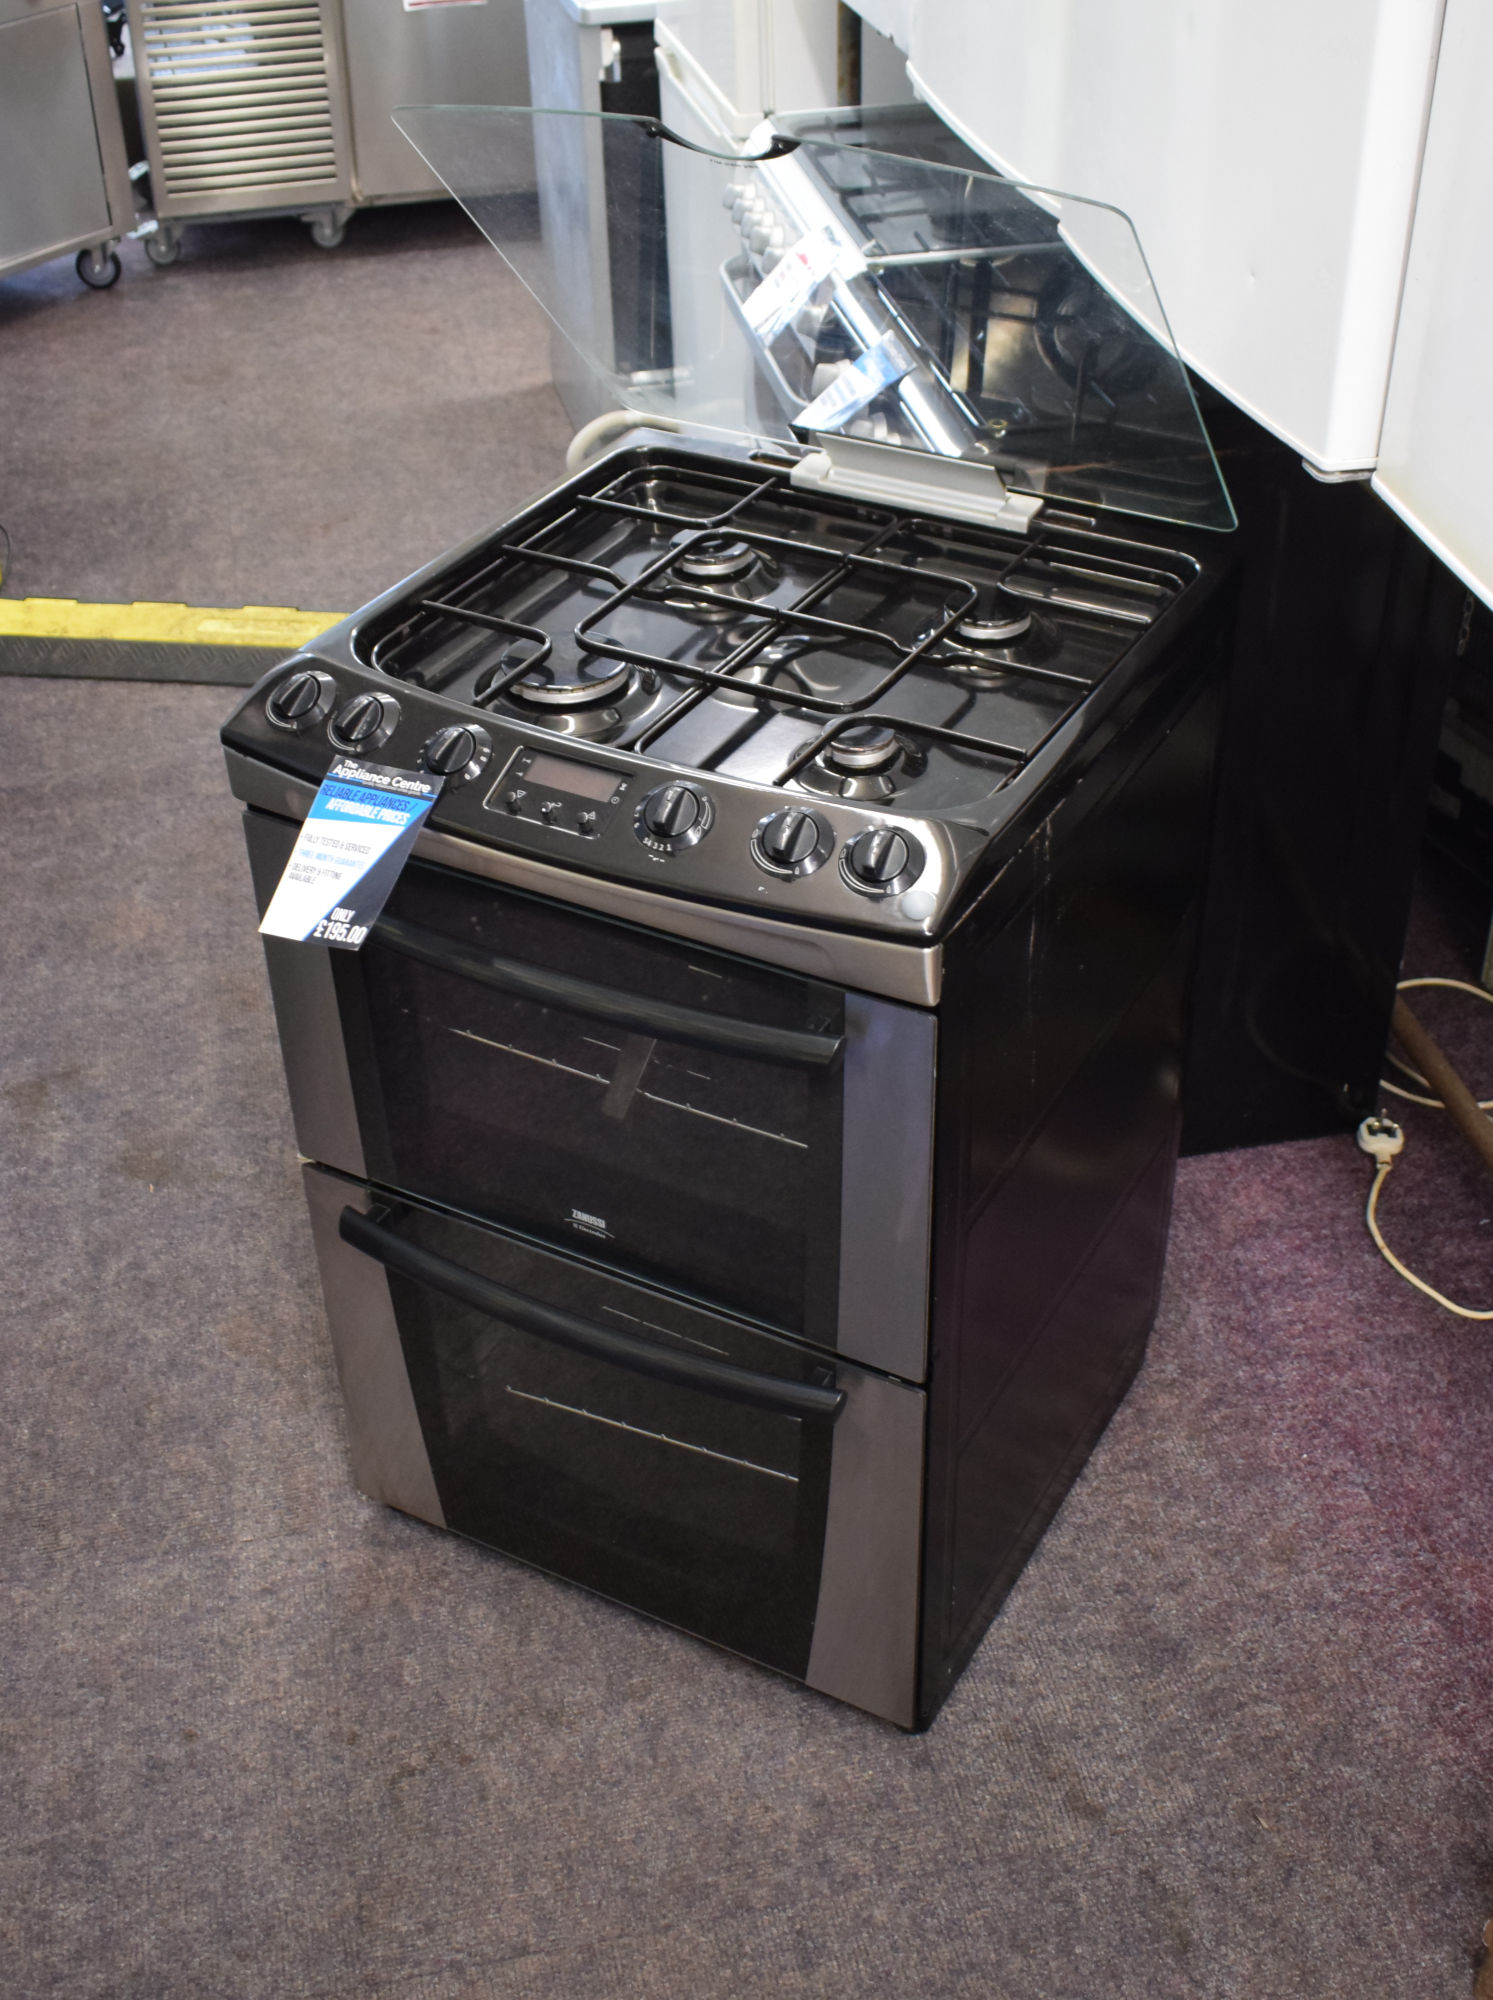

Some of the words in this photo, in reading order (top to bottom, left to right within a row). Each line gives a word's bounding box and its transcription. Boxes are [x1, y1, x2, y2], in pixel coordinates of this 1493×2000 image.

[344, 759, 359, 769] The
[332, 764, 391, 784] Appliance
[391, 777, 432, 793] Centre
[319, 784, 359, 800] RELIABLE
[359, 791, 410, 811] APPLIANCES
[325, 798, 380, 818] AFFORDABLE
[377, 809, 411, 825] PRICES
[330, 907, 356, 923] ONLY
[313, 919, 368, 944] £195.00
